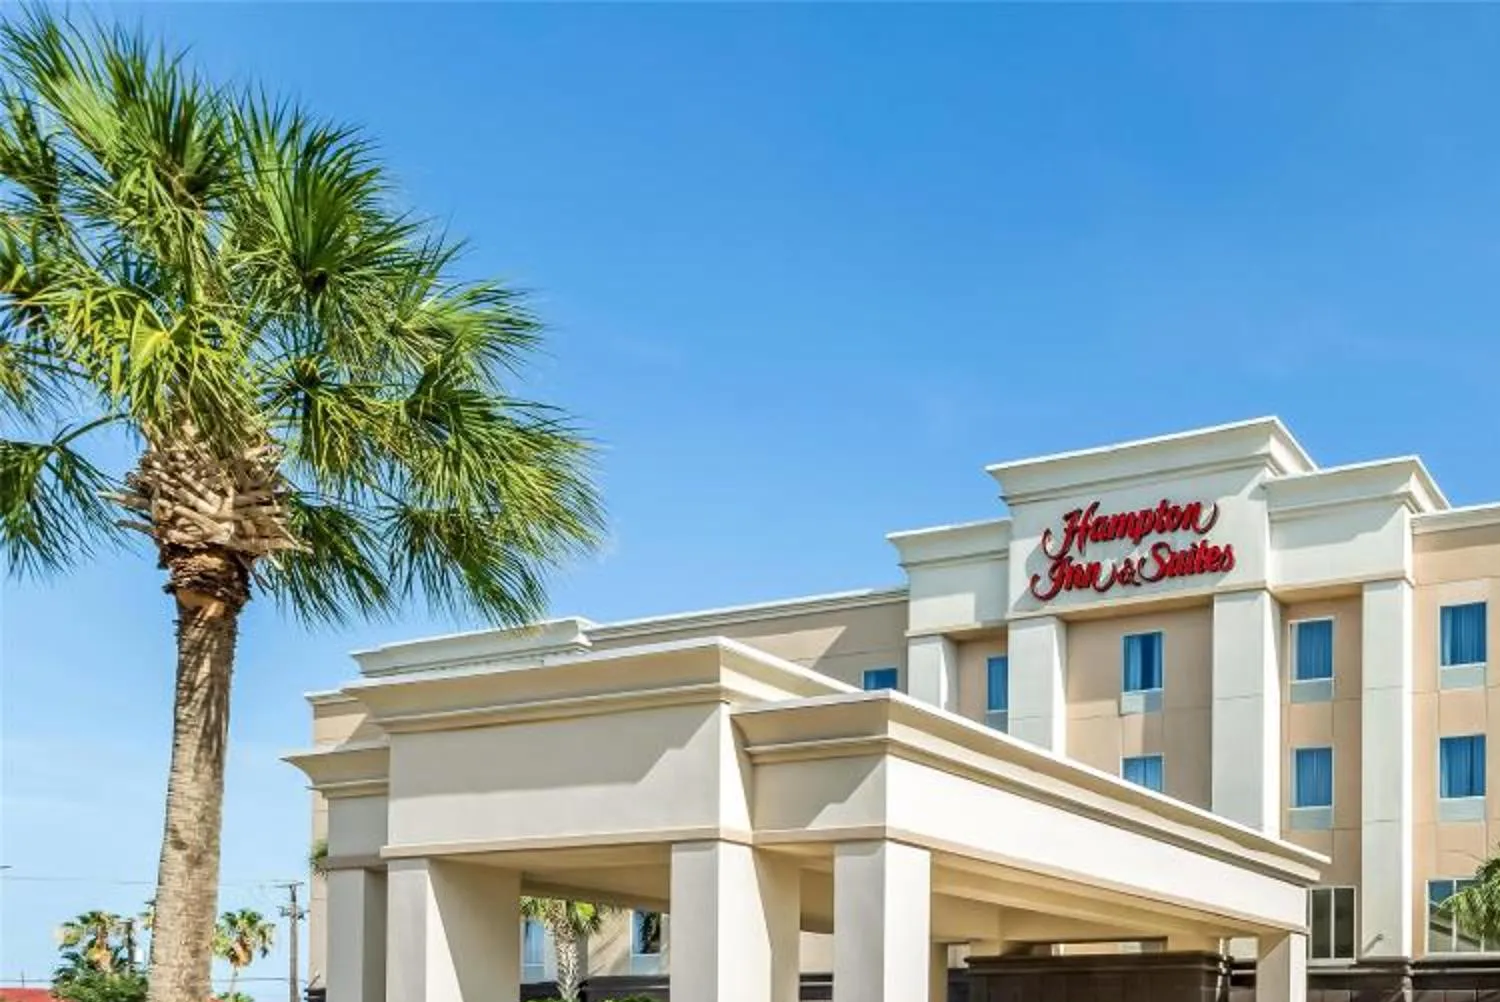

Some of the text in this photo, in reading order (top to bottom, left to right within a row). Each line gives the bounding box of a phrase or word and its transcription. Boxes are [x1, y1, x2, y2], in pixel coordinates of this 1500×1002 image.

[1042, 499, 1218, 560] Hampton
[1030, 540, 1235, 600] Inn & Suites
